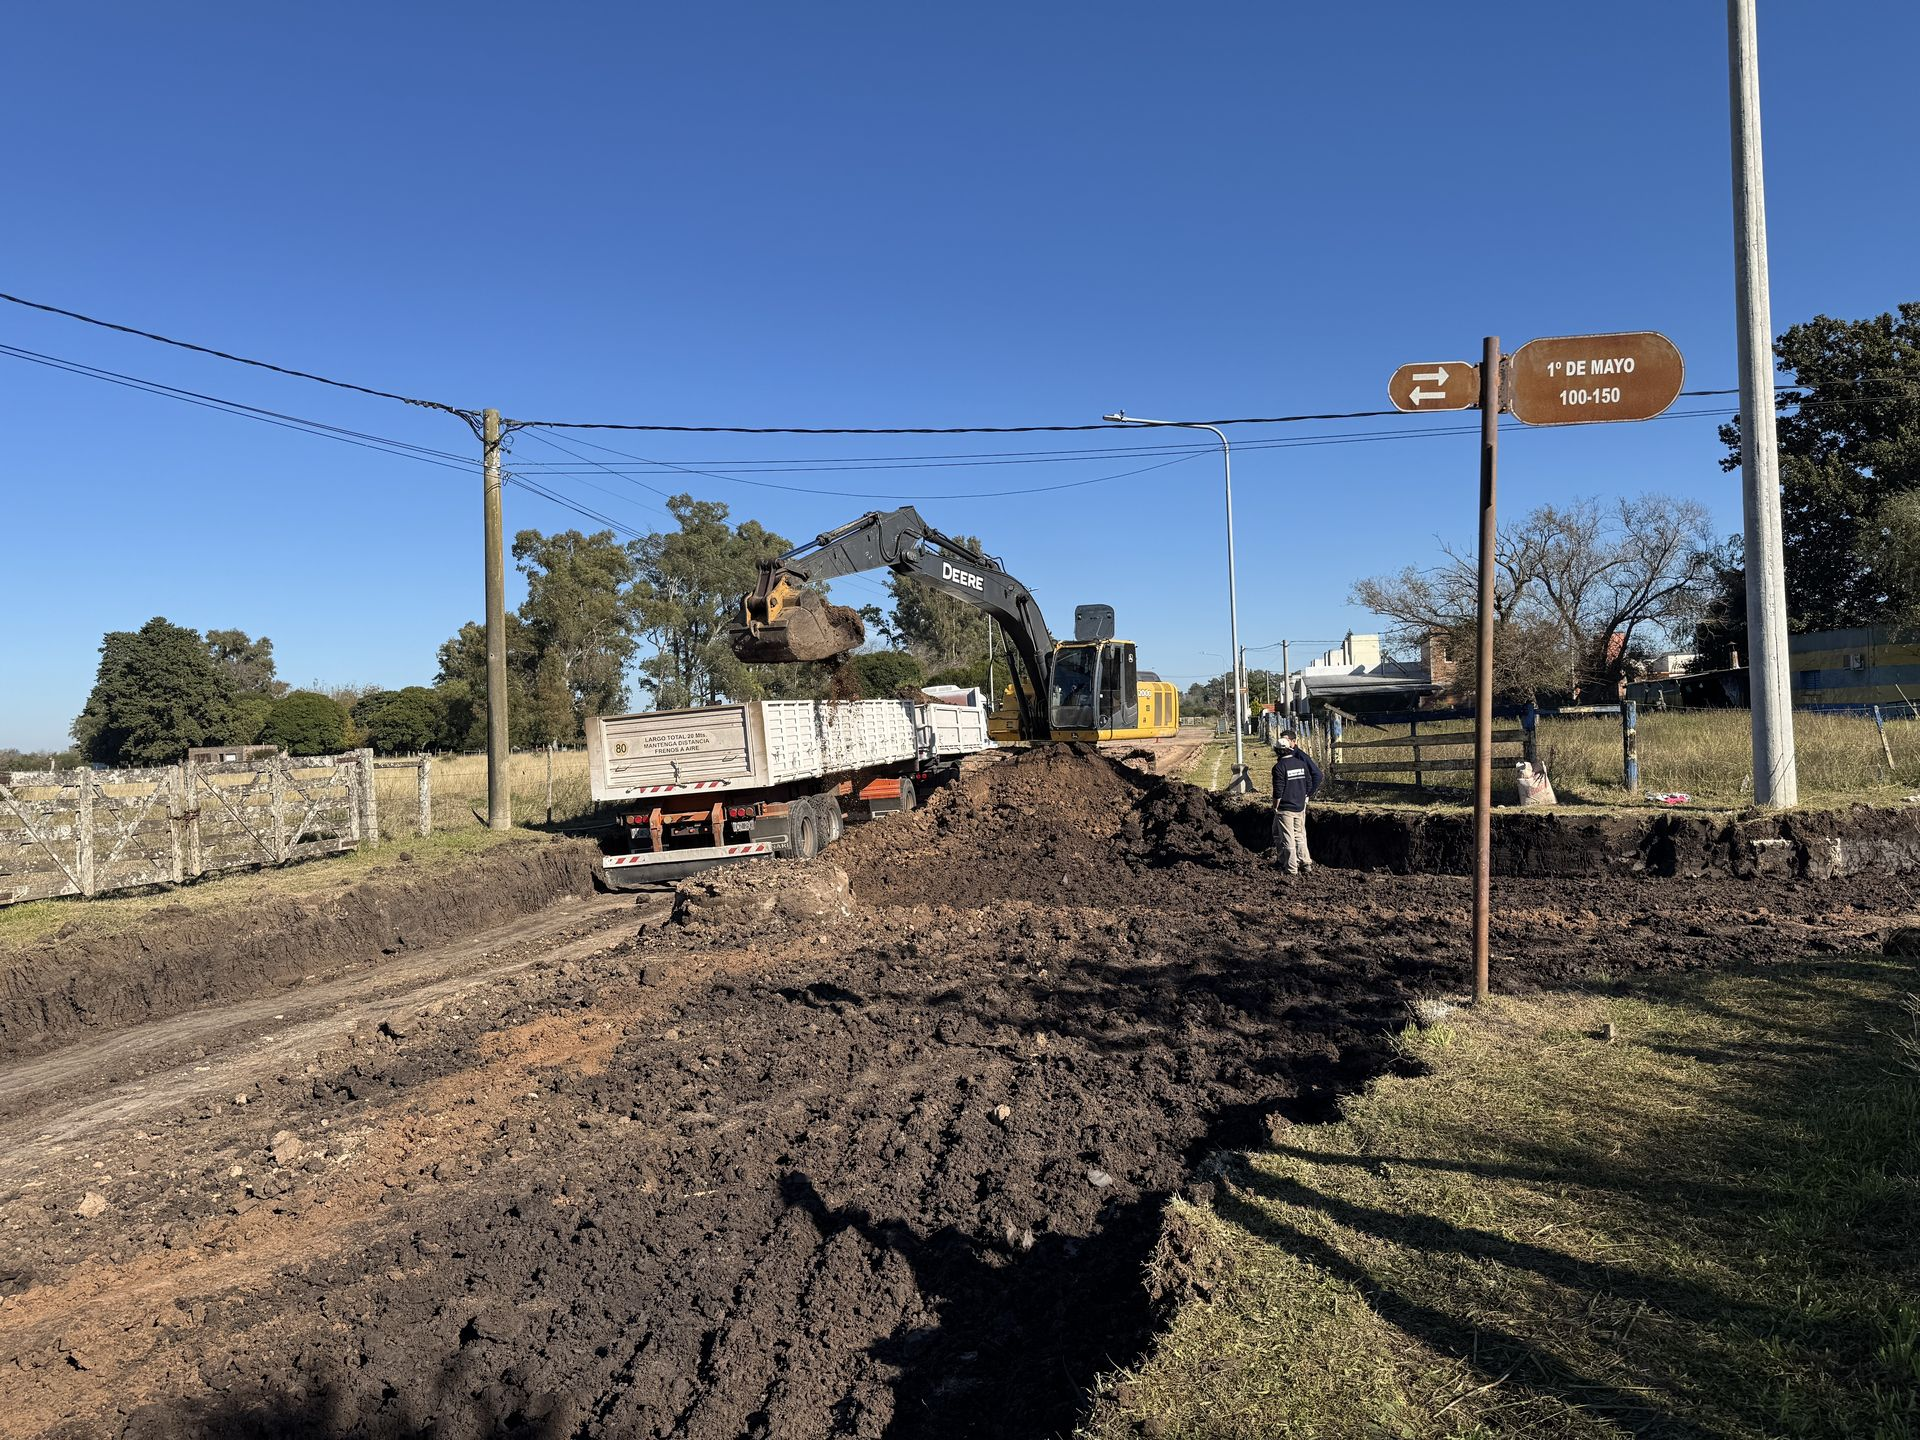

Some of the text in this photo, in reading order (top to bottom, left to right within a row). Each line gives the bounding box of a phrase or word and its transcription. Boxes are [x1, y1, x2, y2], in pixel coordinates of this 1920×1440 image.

[1566, 360, 1586, 376] DE
[1591, 357, 1635, 375] MAYO
[1560, 387, 1620, 405] 100-150
[942, 561, 984, 591] DEERE
[615, 743, 627, 753] 80
[678, 738, 710, 746] DISTANCIA
